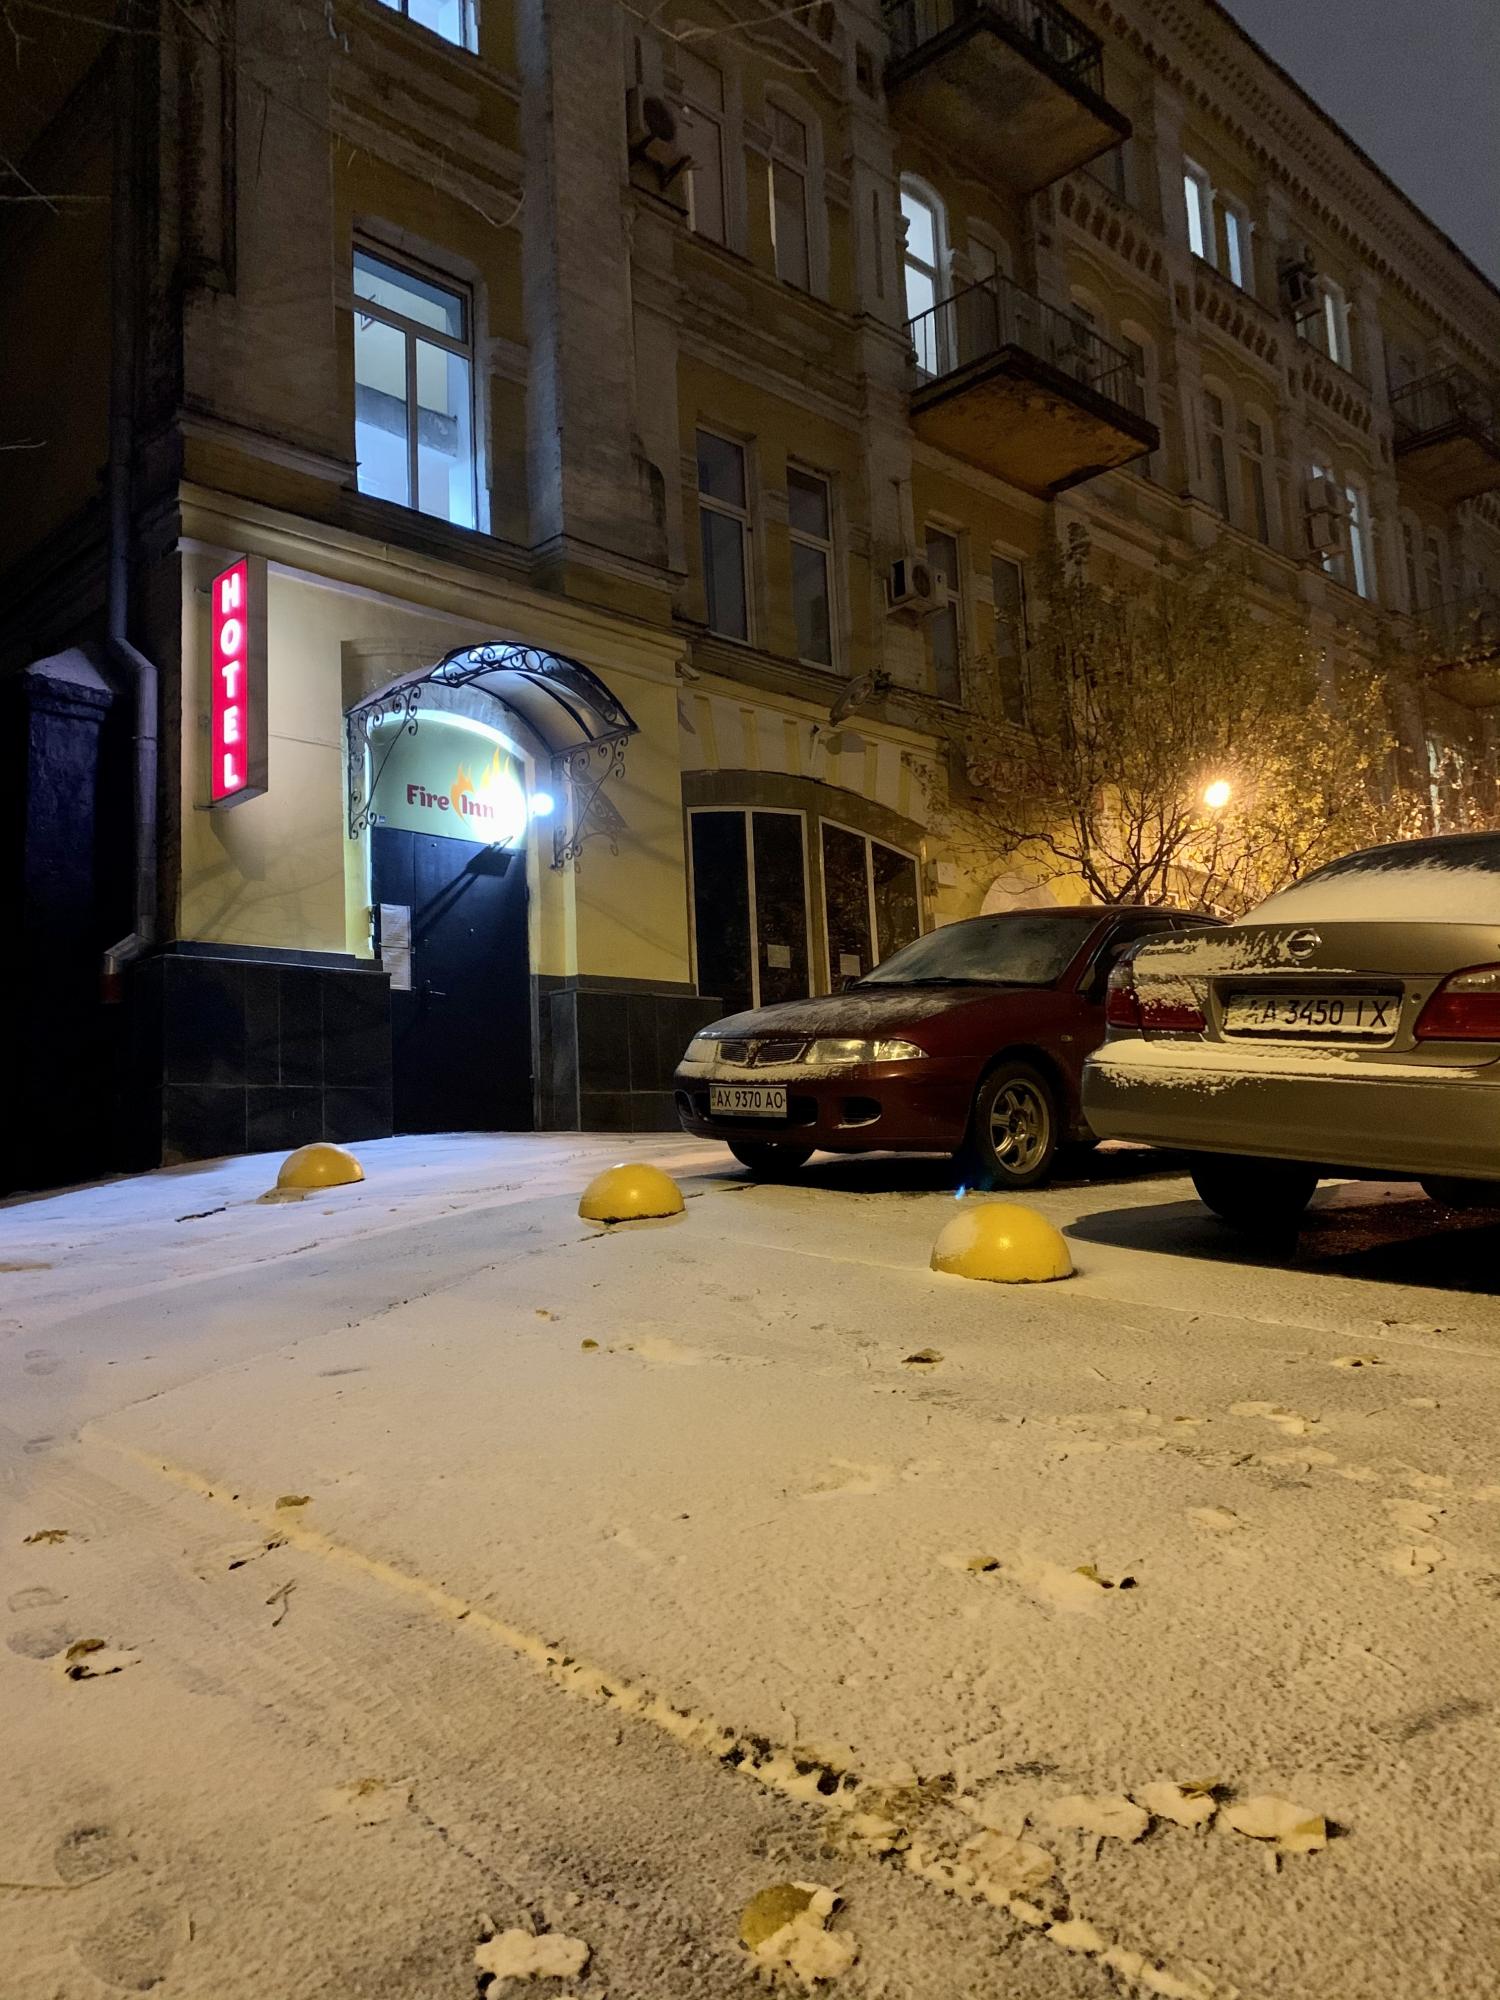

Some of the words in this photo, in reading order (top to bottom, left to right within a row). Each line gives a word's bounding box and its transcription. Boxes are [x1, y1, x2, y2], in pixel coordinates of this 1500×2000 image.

[220, 572, 241, 789] HOTEL
[406, 783, 450, 811] Fire
[461, 793, 494, 818] Inn
[1284, 1000, 1345, 1026] 3450
[1356, 1001, 1390, 1027] IX
[716, 1090, 732, 1107] AX
[734, 1091, 762, 1108] 9370
[765, 1092, 783, 1109] AO
